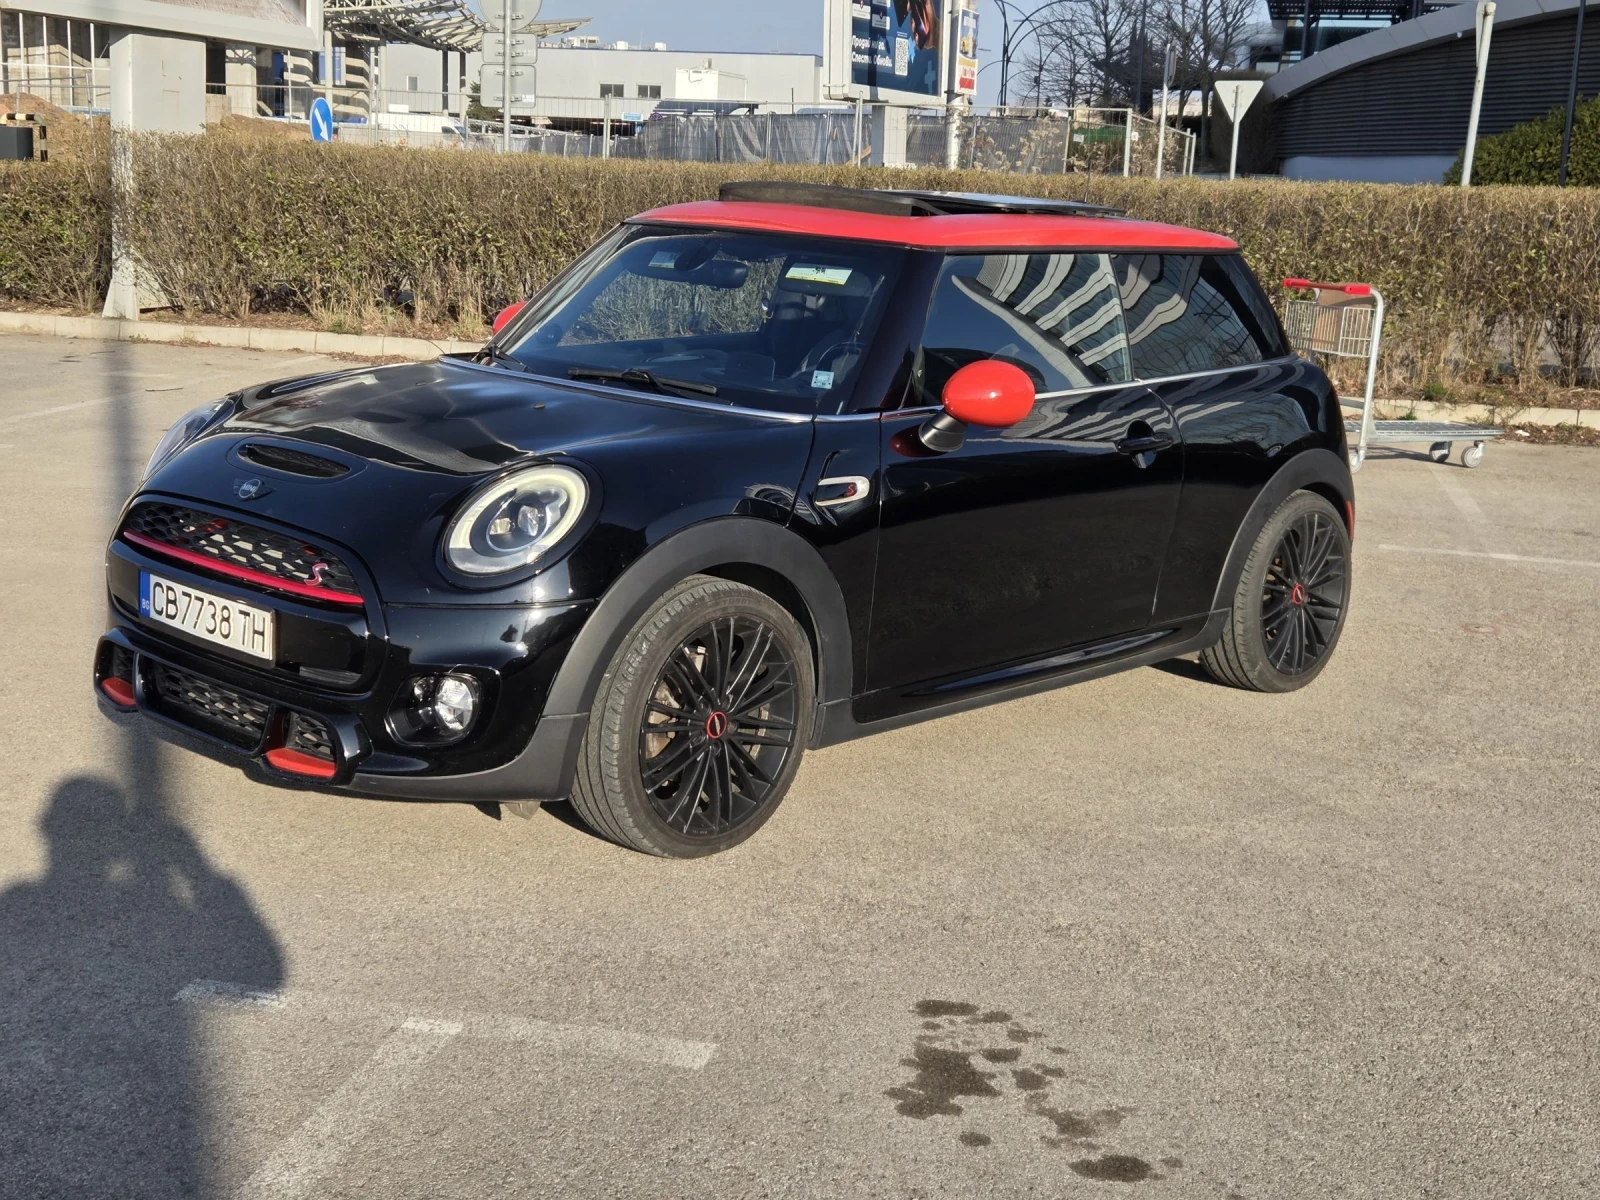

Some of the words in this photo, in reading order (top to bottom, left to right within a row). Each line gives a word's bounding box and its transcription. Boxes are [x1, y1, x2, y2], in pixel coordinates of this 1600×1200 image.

[304, 563, 329, 586] S
[142, 598, 150, 610] BG
[239, 609, 266, 653] TH
